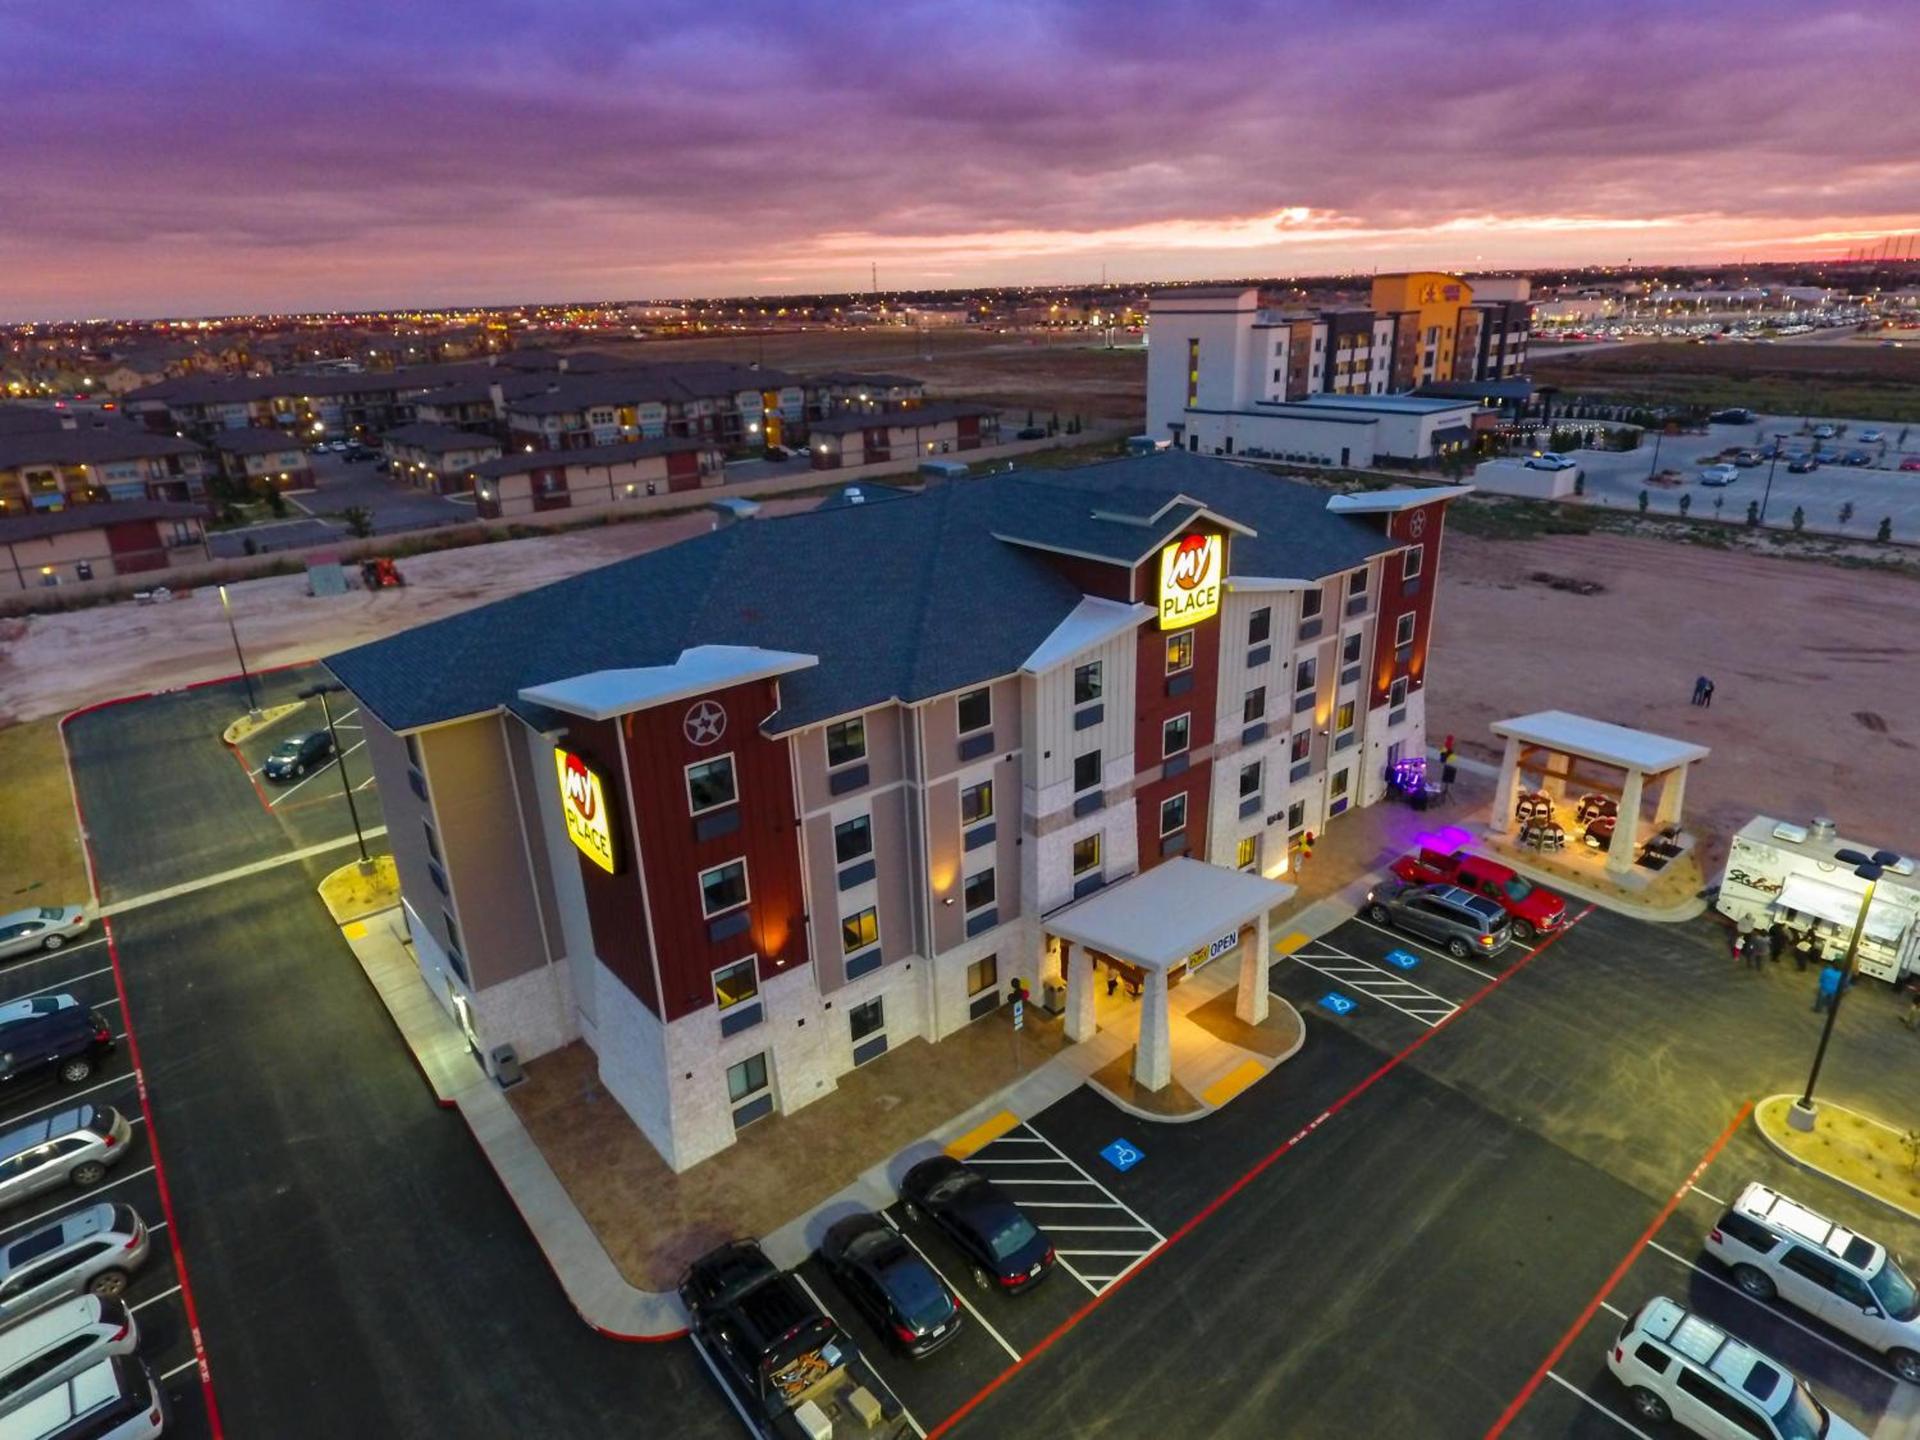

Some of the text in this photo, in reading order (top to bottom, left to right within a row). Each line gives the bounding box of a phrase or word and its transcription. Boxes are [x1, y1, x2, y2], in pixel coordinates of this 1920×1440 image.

[1164, 586, 1216, 617] PLACE
[567, 808, 609, 858] PLACE
[1210, 931, 1236, 957] OPEN
